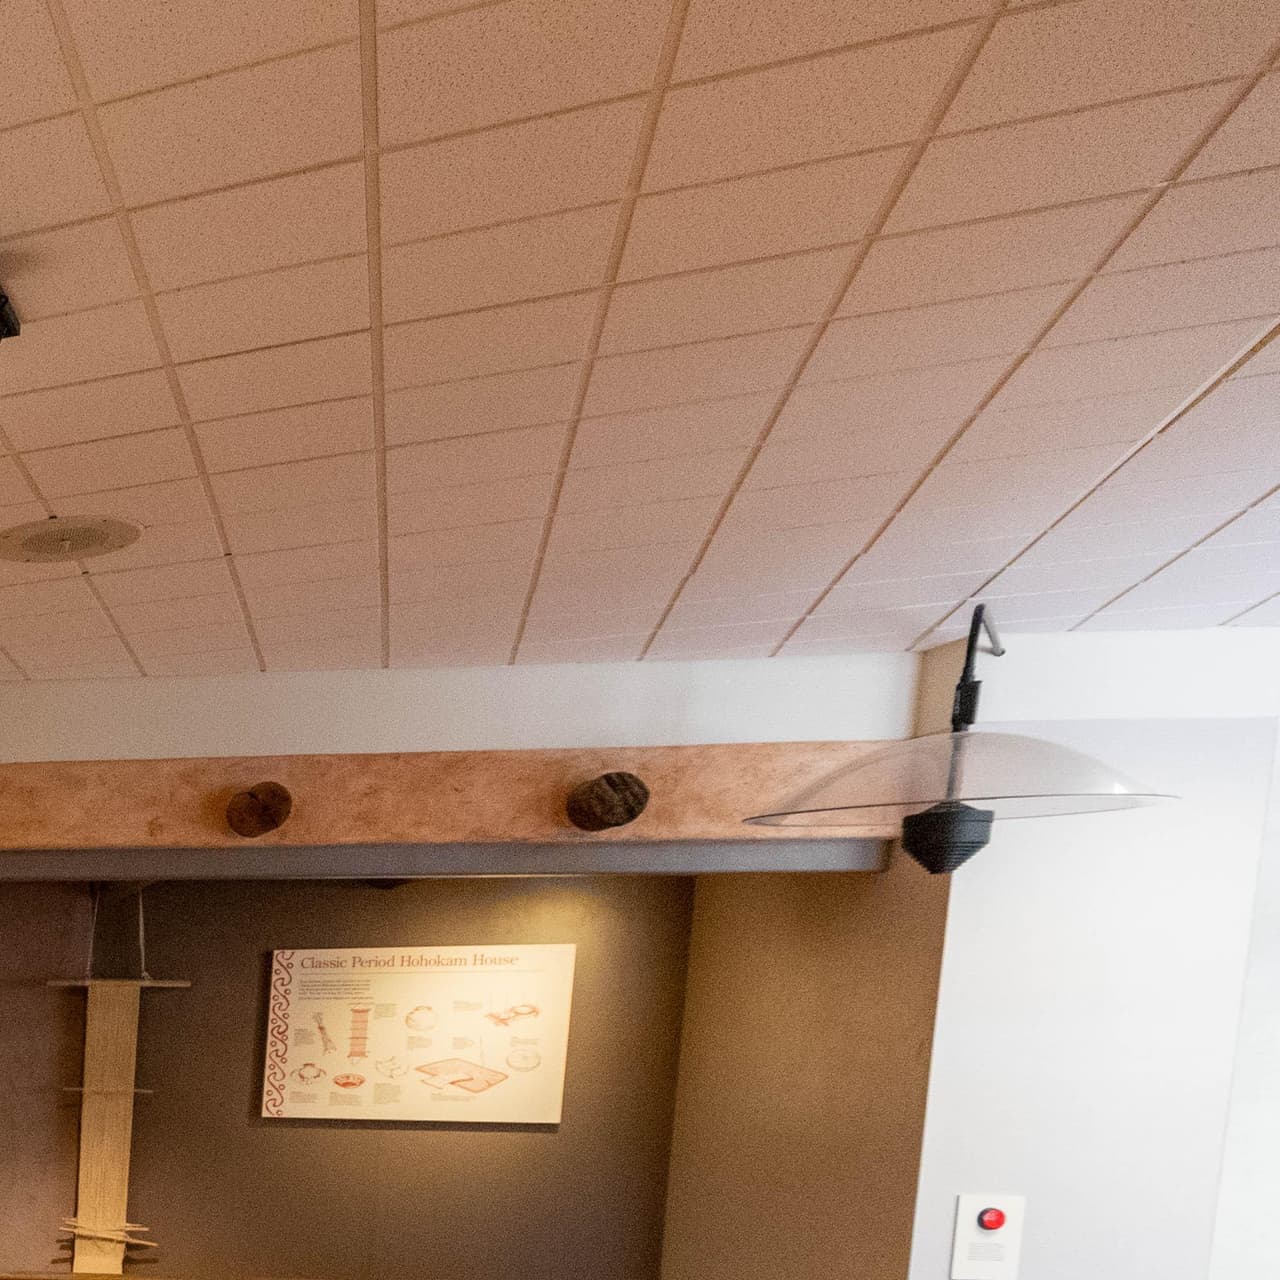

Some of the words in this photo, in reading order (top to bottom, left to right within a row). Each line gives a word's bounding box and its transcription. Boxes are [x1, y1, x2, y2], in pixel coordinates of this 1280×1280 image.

[301, 956, 347, 969] Classic
[352, 956, 395, 968] Period
[400, 954, 468, 967] Hohokam
[473, 953, 519, 966] House
